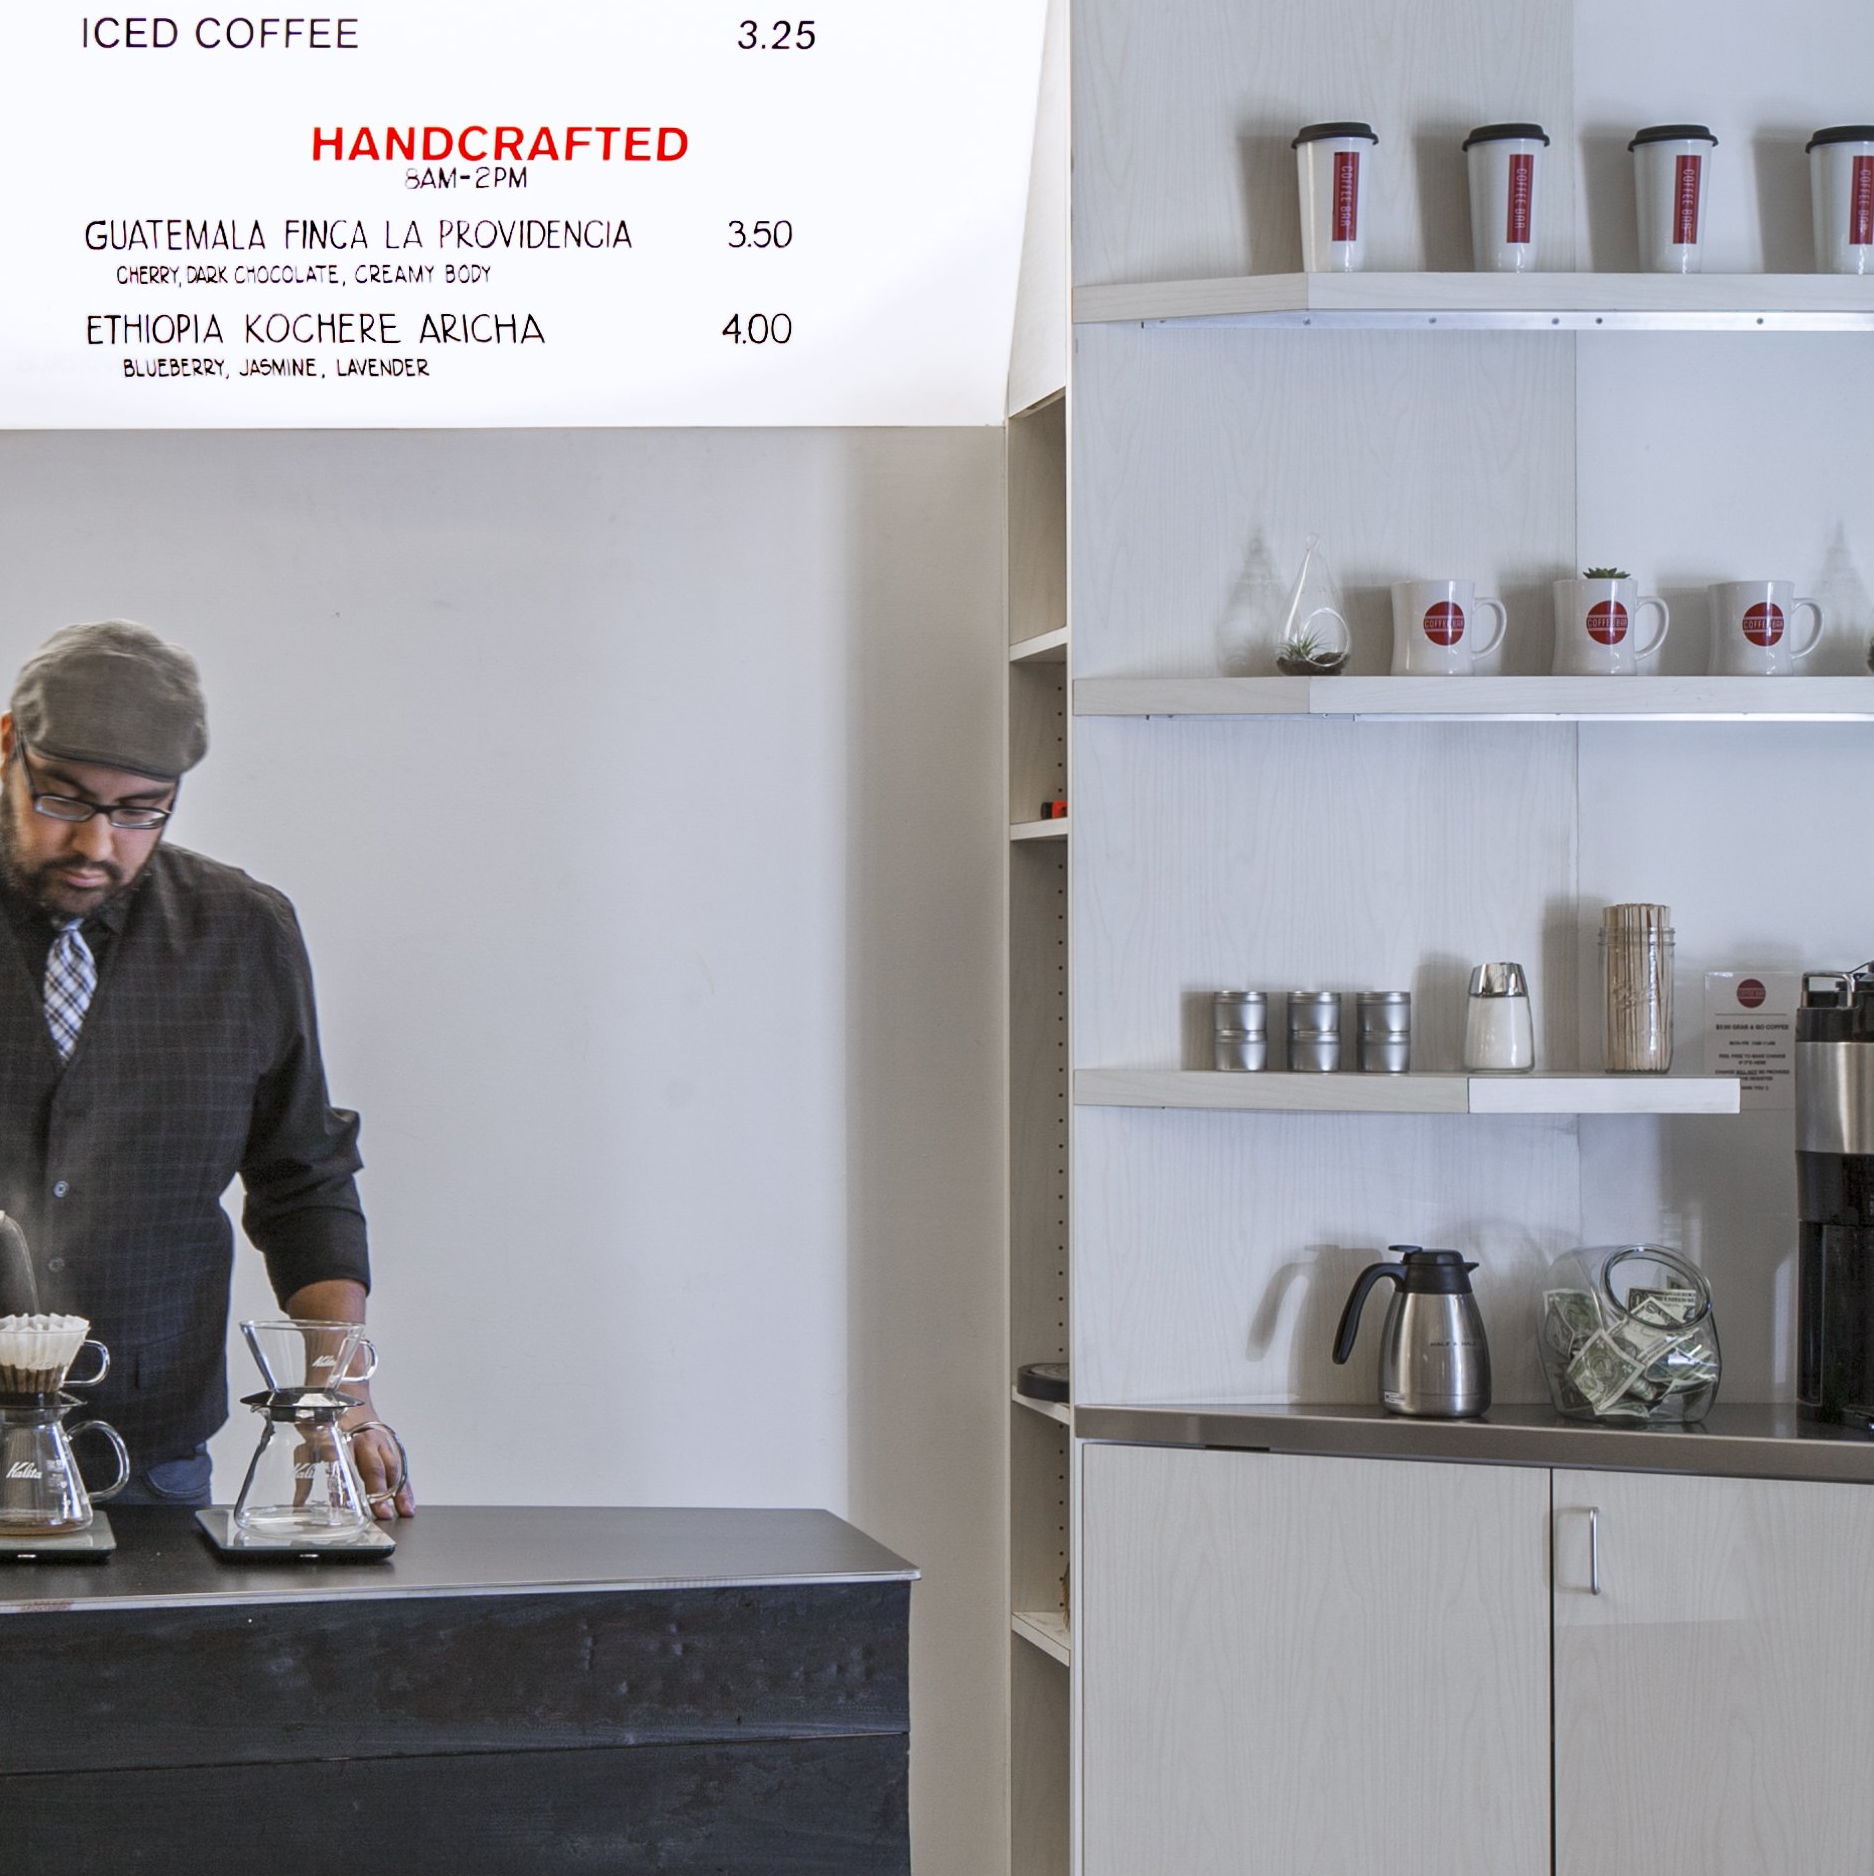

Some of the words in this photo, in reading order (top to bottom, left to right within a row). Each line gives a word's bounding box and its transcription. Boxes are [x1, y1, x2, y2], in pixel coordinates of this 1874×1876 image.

[83, 17, 178, 48] ICED
[195, 17, 358, 49] COFFEE
[738, 20, 815, 49] 3.25
[313, 125, 688, 161] HANDCRAFTED
[405, 166, 527, 189] 8AM-2PM
[1340, 165, 1353, 202] COFFEE
[1515, 168, 1528, 204] COFFEE
[1682, 169, 1694, 205] COFFEE
[85, 219, 266, 250] GUATEMALA
[286, 220, 368, 249] FINCA
[386, 220, 423, 249] LA
[440, 220, 632, 249] PROVIDENCIA
[729, 220, 792, 248] 3.50
[117, 266, 181, 288] CHERRY,
[187, 266, 228, 284] DARK
[235, 265, 345, 287] CHOCOLATE,
[355, 265, 434, 284] CREAMY
[446, 264, 491, 283] BODY
[87, 314, 223, 345] ETHIOPIA
[246, 313, 401, 343] KOCHERE
[419, 313, 545, 344] ARICHA
[722, 313, 792, 344] 4.00
[123, 358, 229, 379] BLUEBERRY,
[239, 358, 325, 379] JASMINE,
[337, 358, 430, 377] LAVENDER
[6, 1461, 42, 1479] Kalita
